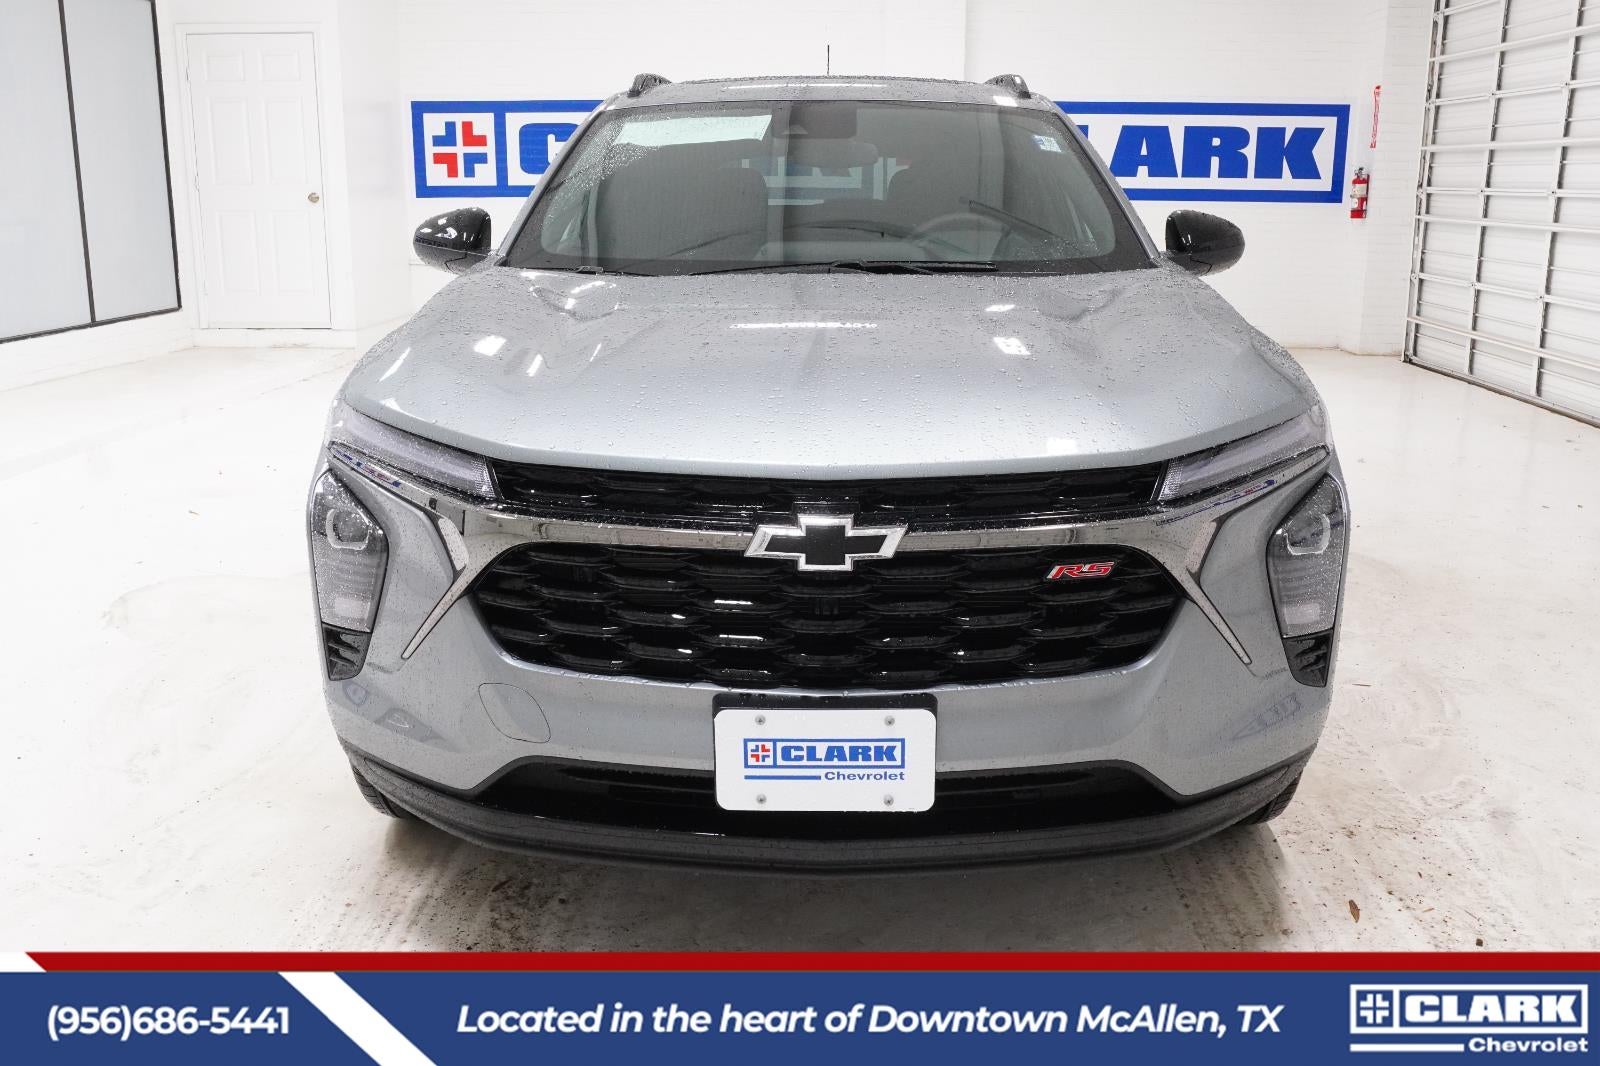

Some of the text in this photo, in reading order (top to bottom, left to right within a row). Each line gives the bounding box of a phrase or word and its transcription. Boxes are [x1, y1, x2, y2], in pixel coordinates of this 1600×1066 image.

[1077, 124, 1325, 180] ARK
[1046, 561, 1115, 579] RS
[780, 745, 897, 762] CLARK
[824, 771, 905, 781] Chevrolet
